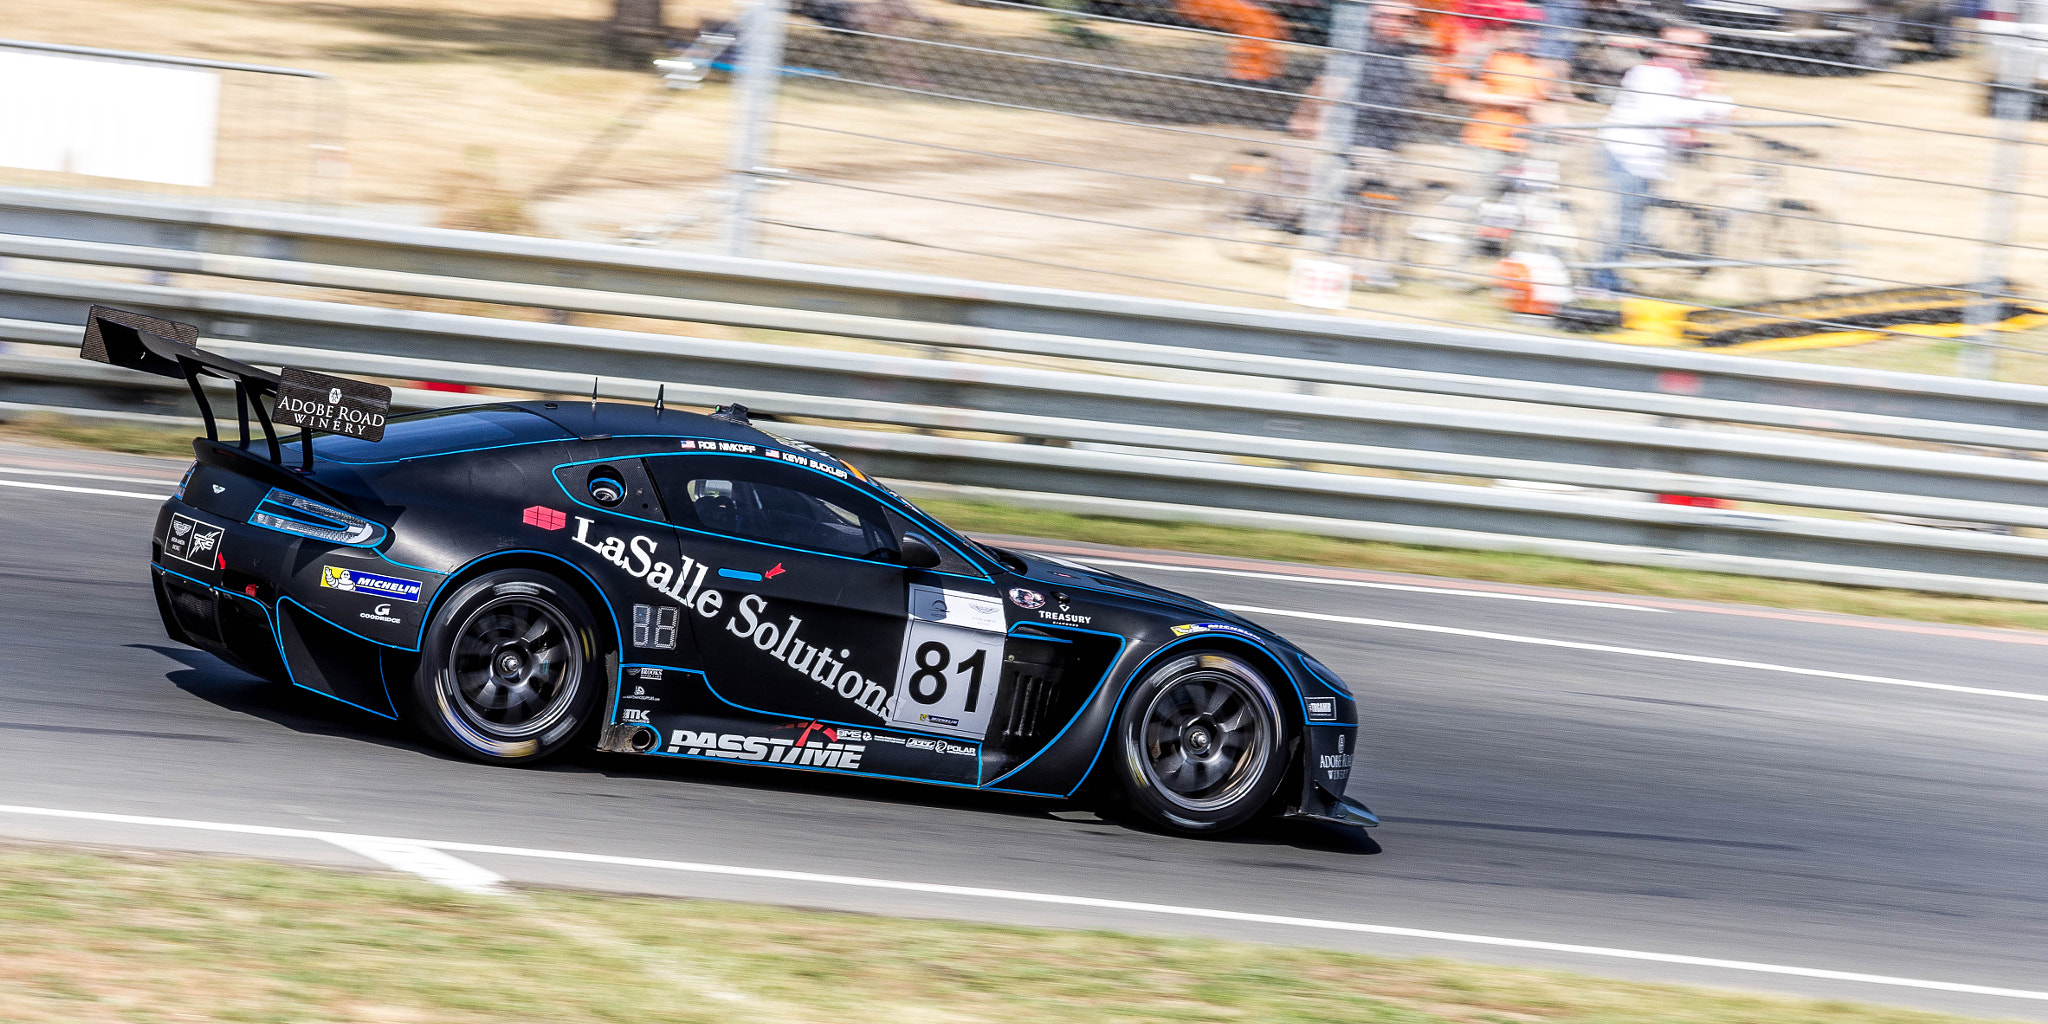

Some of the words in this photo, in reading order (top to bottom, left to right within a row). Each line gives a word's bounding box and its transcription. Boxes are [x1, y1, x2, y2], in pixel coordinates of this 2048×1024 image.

[278, 395, 334, 420] ADOBE
[338, 405, 385, 428] ROAD
[293, 412, 367, 436] WINERY
[697, 440, 717, 451] ROB
[719, 442, 757, 454] NIMKOFF
[782, 452, 808, 466] KEVIN
[809, 459, 848, 480] BUCKLER
[356, 576, 420, 595] MICHELIN
[359, 612, 402, 624] GOODRIDGE
[572, 516, 724, 619] LaSalle
[725, 593, 906, 722] Solutions
[1038, 609, 1092, 625] TREASURY
[1207, 624, 1262, 641] MICHELIN
[908, 640, 987, 713] 81
[931, 716, 959, 725] MICHELIN
[667, 729, 866, 769] PASSTIME
[946, 744, 976, 754] POLAR
